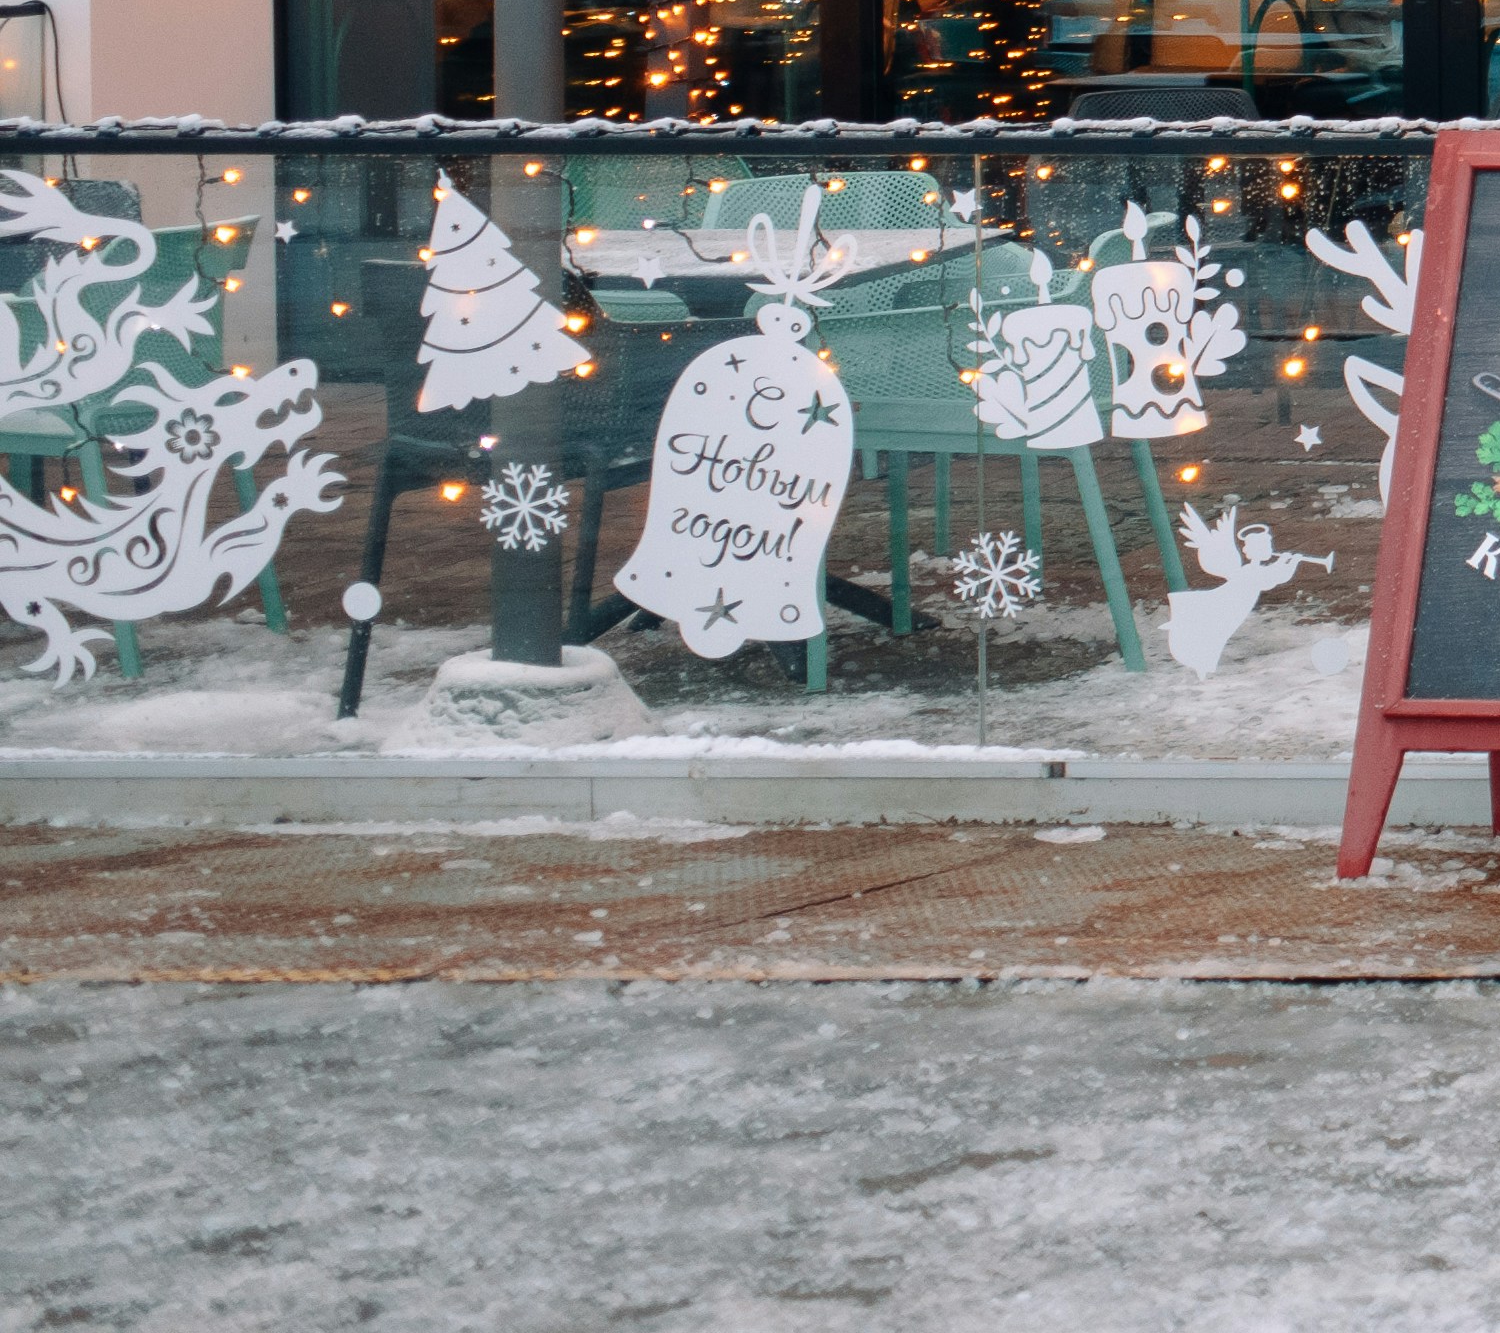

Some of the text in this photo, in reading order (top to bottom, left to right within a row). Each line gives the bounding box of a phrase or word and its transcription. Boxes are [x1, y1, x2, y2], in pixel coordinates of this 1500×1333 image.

[745, 376, 785, 431] С
[667, 433, 832, 510] Новым
[671, 507, 804, 568] годом!
